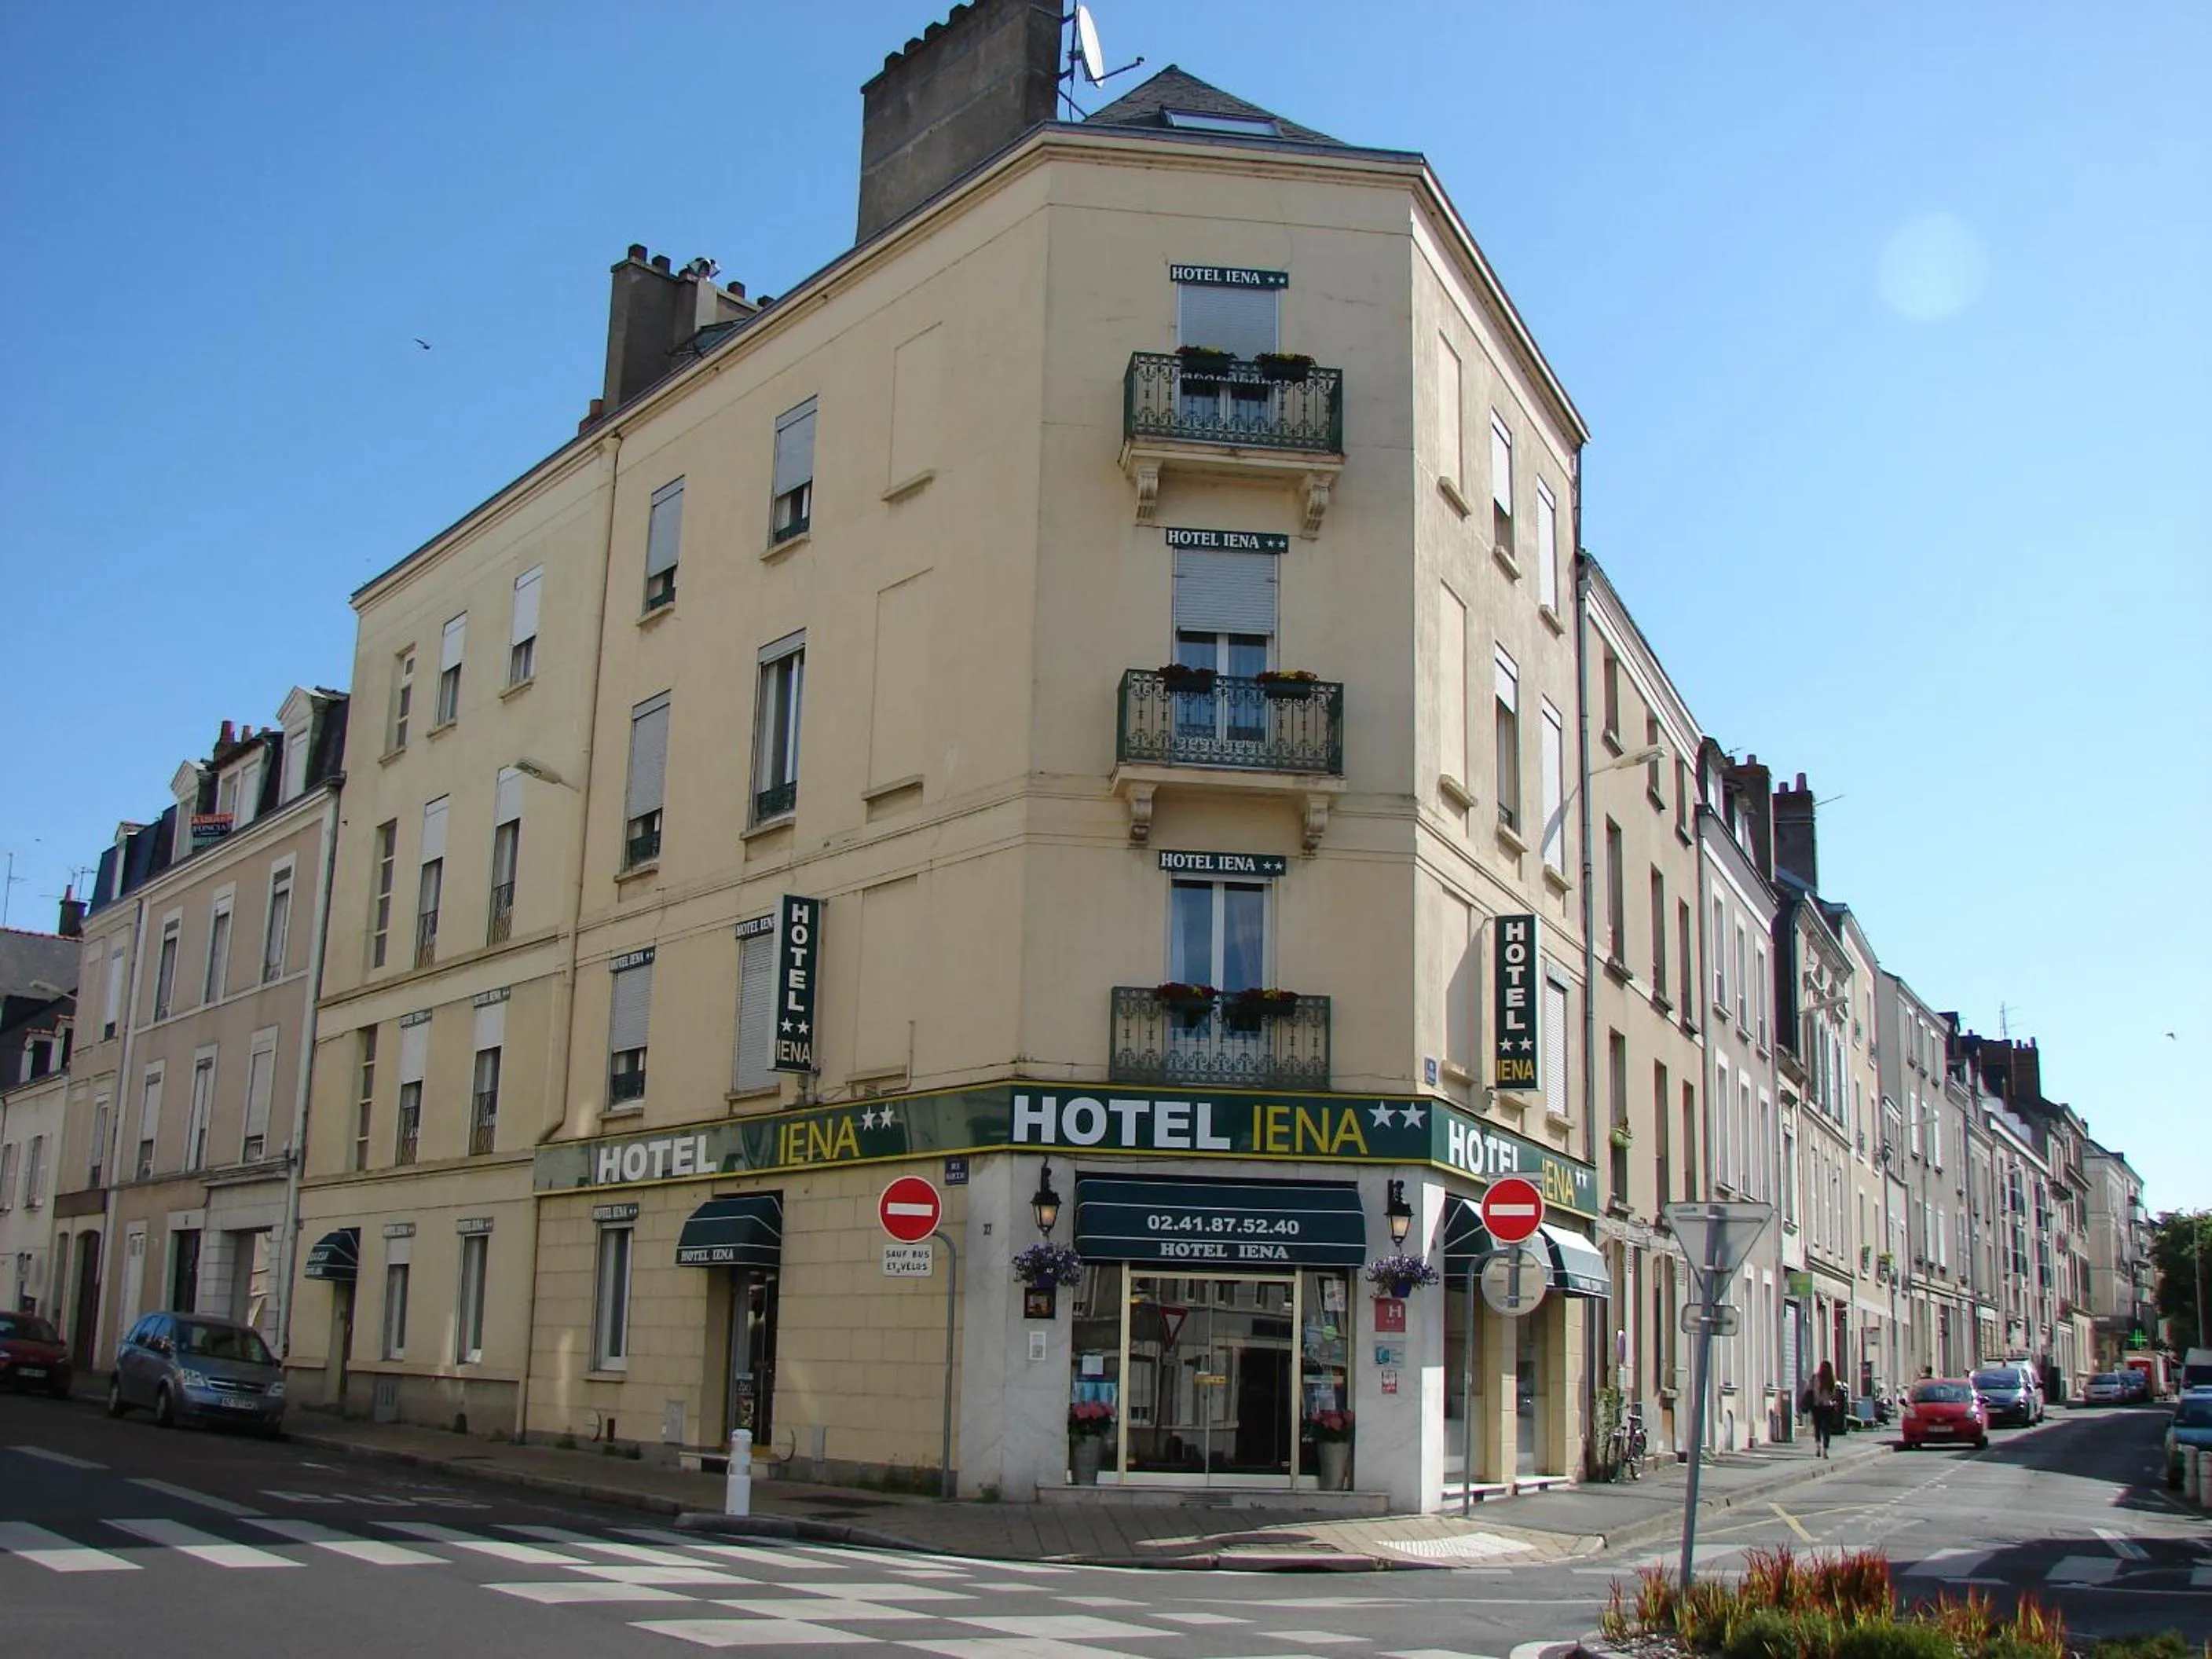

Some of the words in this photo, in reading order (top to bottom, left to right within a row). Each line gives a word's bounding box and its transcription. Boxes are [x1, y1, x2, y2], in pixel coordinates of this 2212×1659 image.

[1171, 266, 1221, 282] HOTEL
[1225, 270, 1260, 284] IENA
[1167, 530, 1218, 546] HOTEL
[1223, 533, 1259, 549] IENA
[1161, 852, 1214, 870] HOTEL
[1218, 856, 1256, 872] IENA
[787, 903, 810, 1012] HOTEL
[1505, 921, 1525, 1031] HOTEL
[777, 1039, 811, 1064] IENA
[1497, 1059, 1534, 1081] IENA
[1012, 1095, 1231, 1150] HOTEL
[1253, 1104, 1368, 1154] IENA
[597, 1134, 717, 1184] HOTEL
[779, 1115, 861, 1166] IENA
[1542, 1158, 1576, 1207] IENA
[1147, 1215, 1299, 1234] 02.41.87.52.40
[681, 1250, 709, 1262] HOTEL
[712, 1248, 734, 1260] IENA
[885, 1250, 907, 1258] SAUF
[1160, 1243, 1228, 1258] HOTEL
[1239, 1244, 1289, 1258] IENA
[886, 1262, 897, 1270] ET
[1389, 1305, 1401, 1318] H
